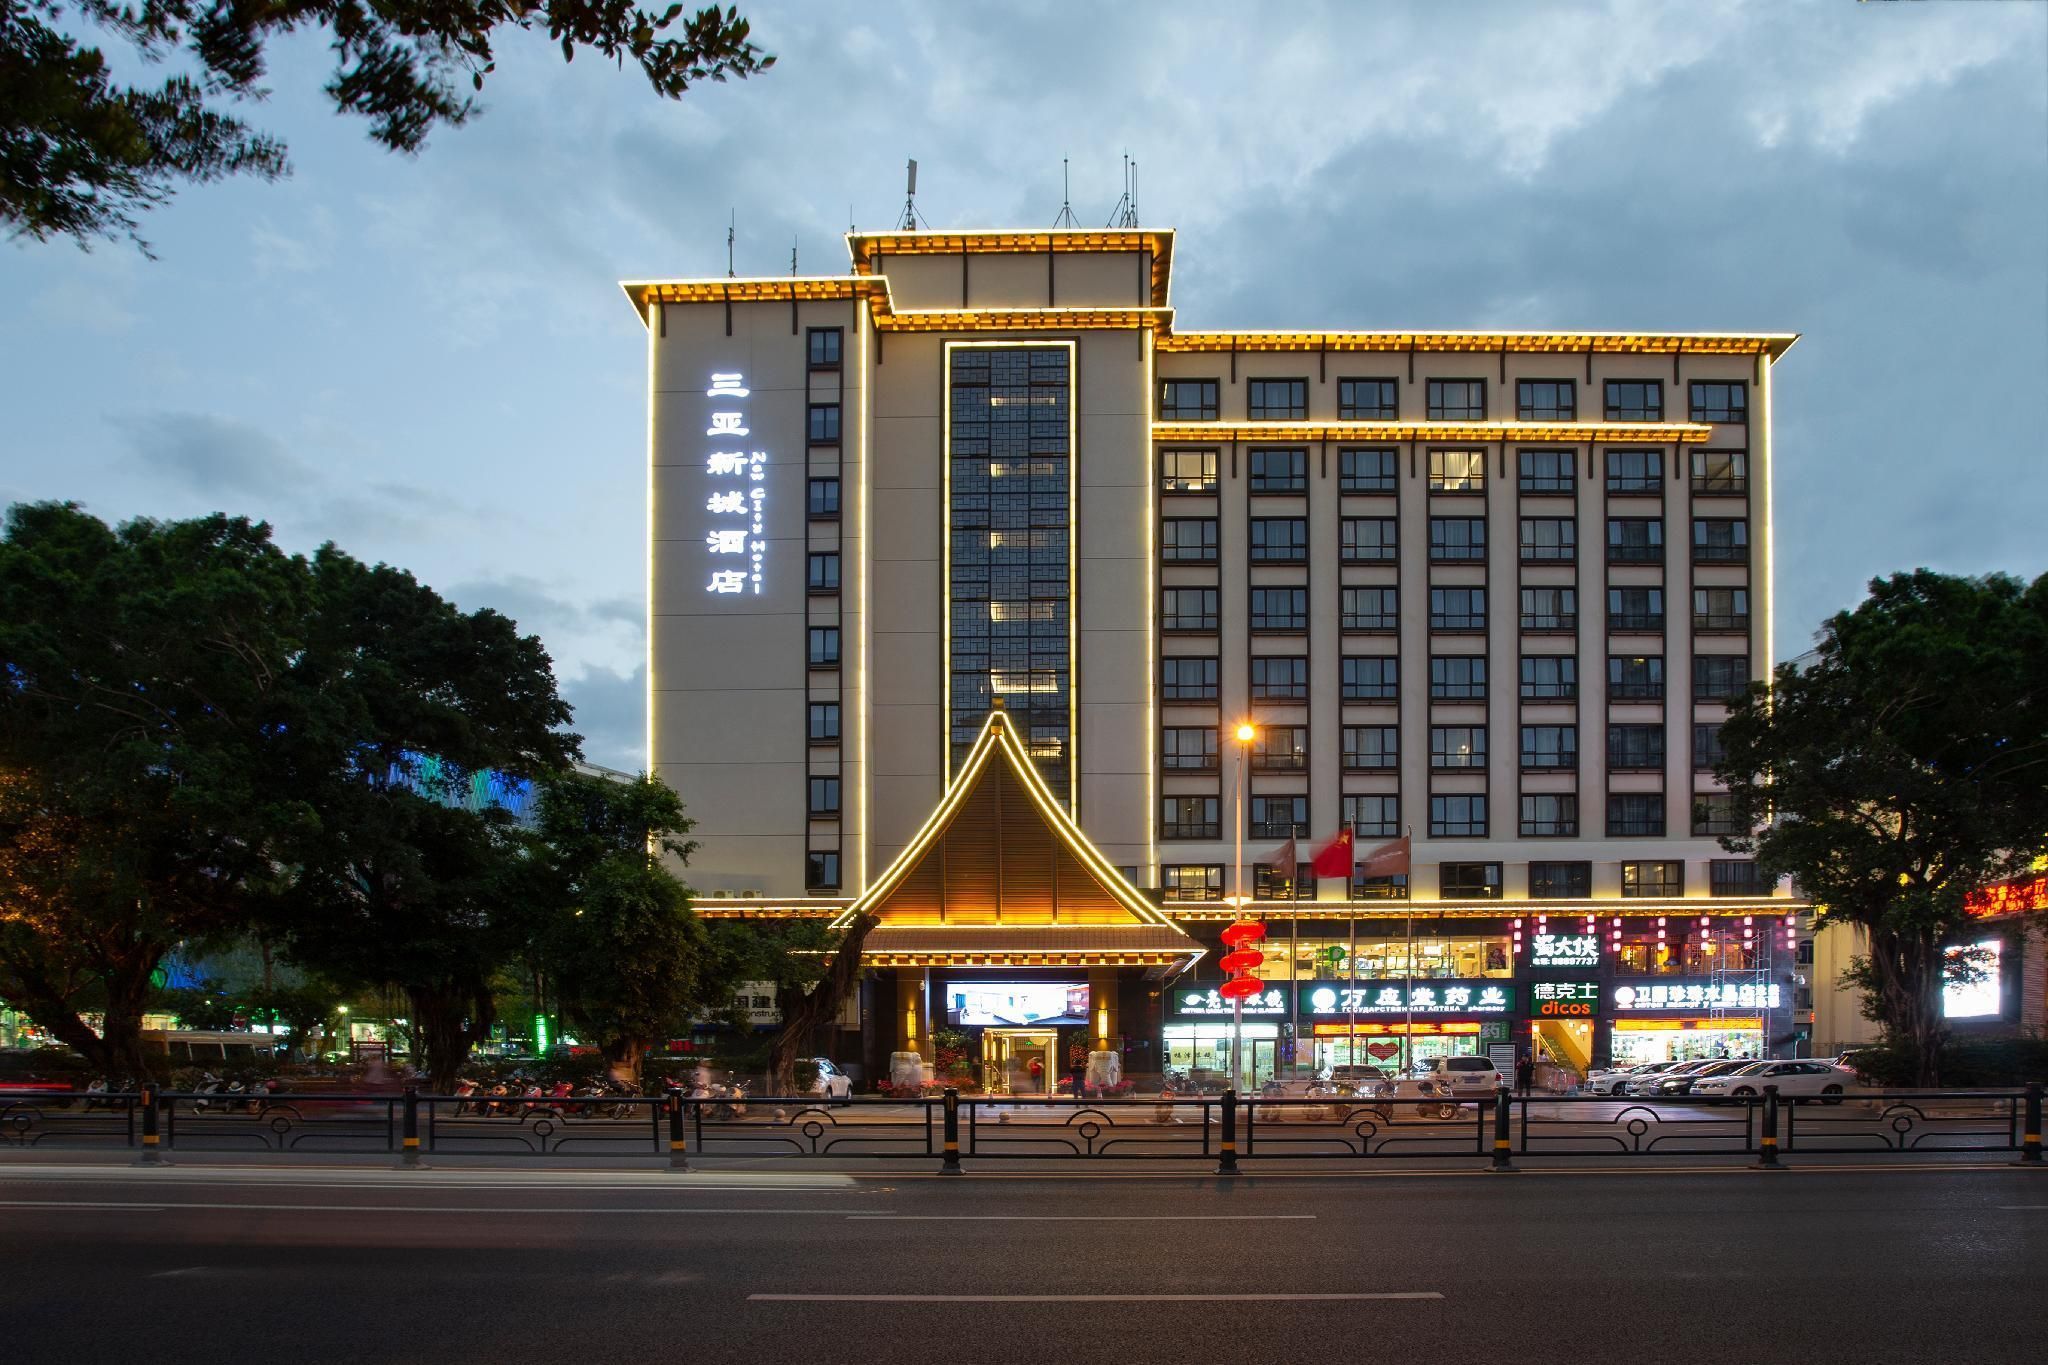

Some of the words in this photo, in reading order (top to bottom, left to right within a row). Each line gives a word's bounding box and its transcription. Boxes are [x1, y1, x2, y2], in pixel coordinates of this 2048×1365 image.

[706, 373, 750, 594] 三亚新城酒店
[1534, 982, 1599, 999] 德克士
[1541, 1001, 1591, 1015] dicos
[1481, 1021, 1501, 1039] 药
